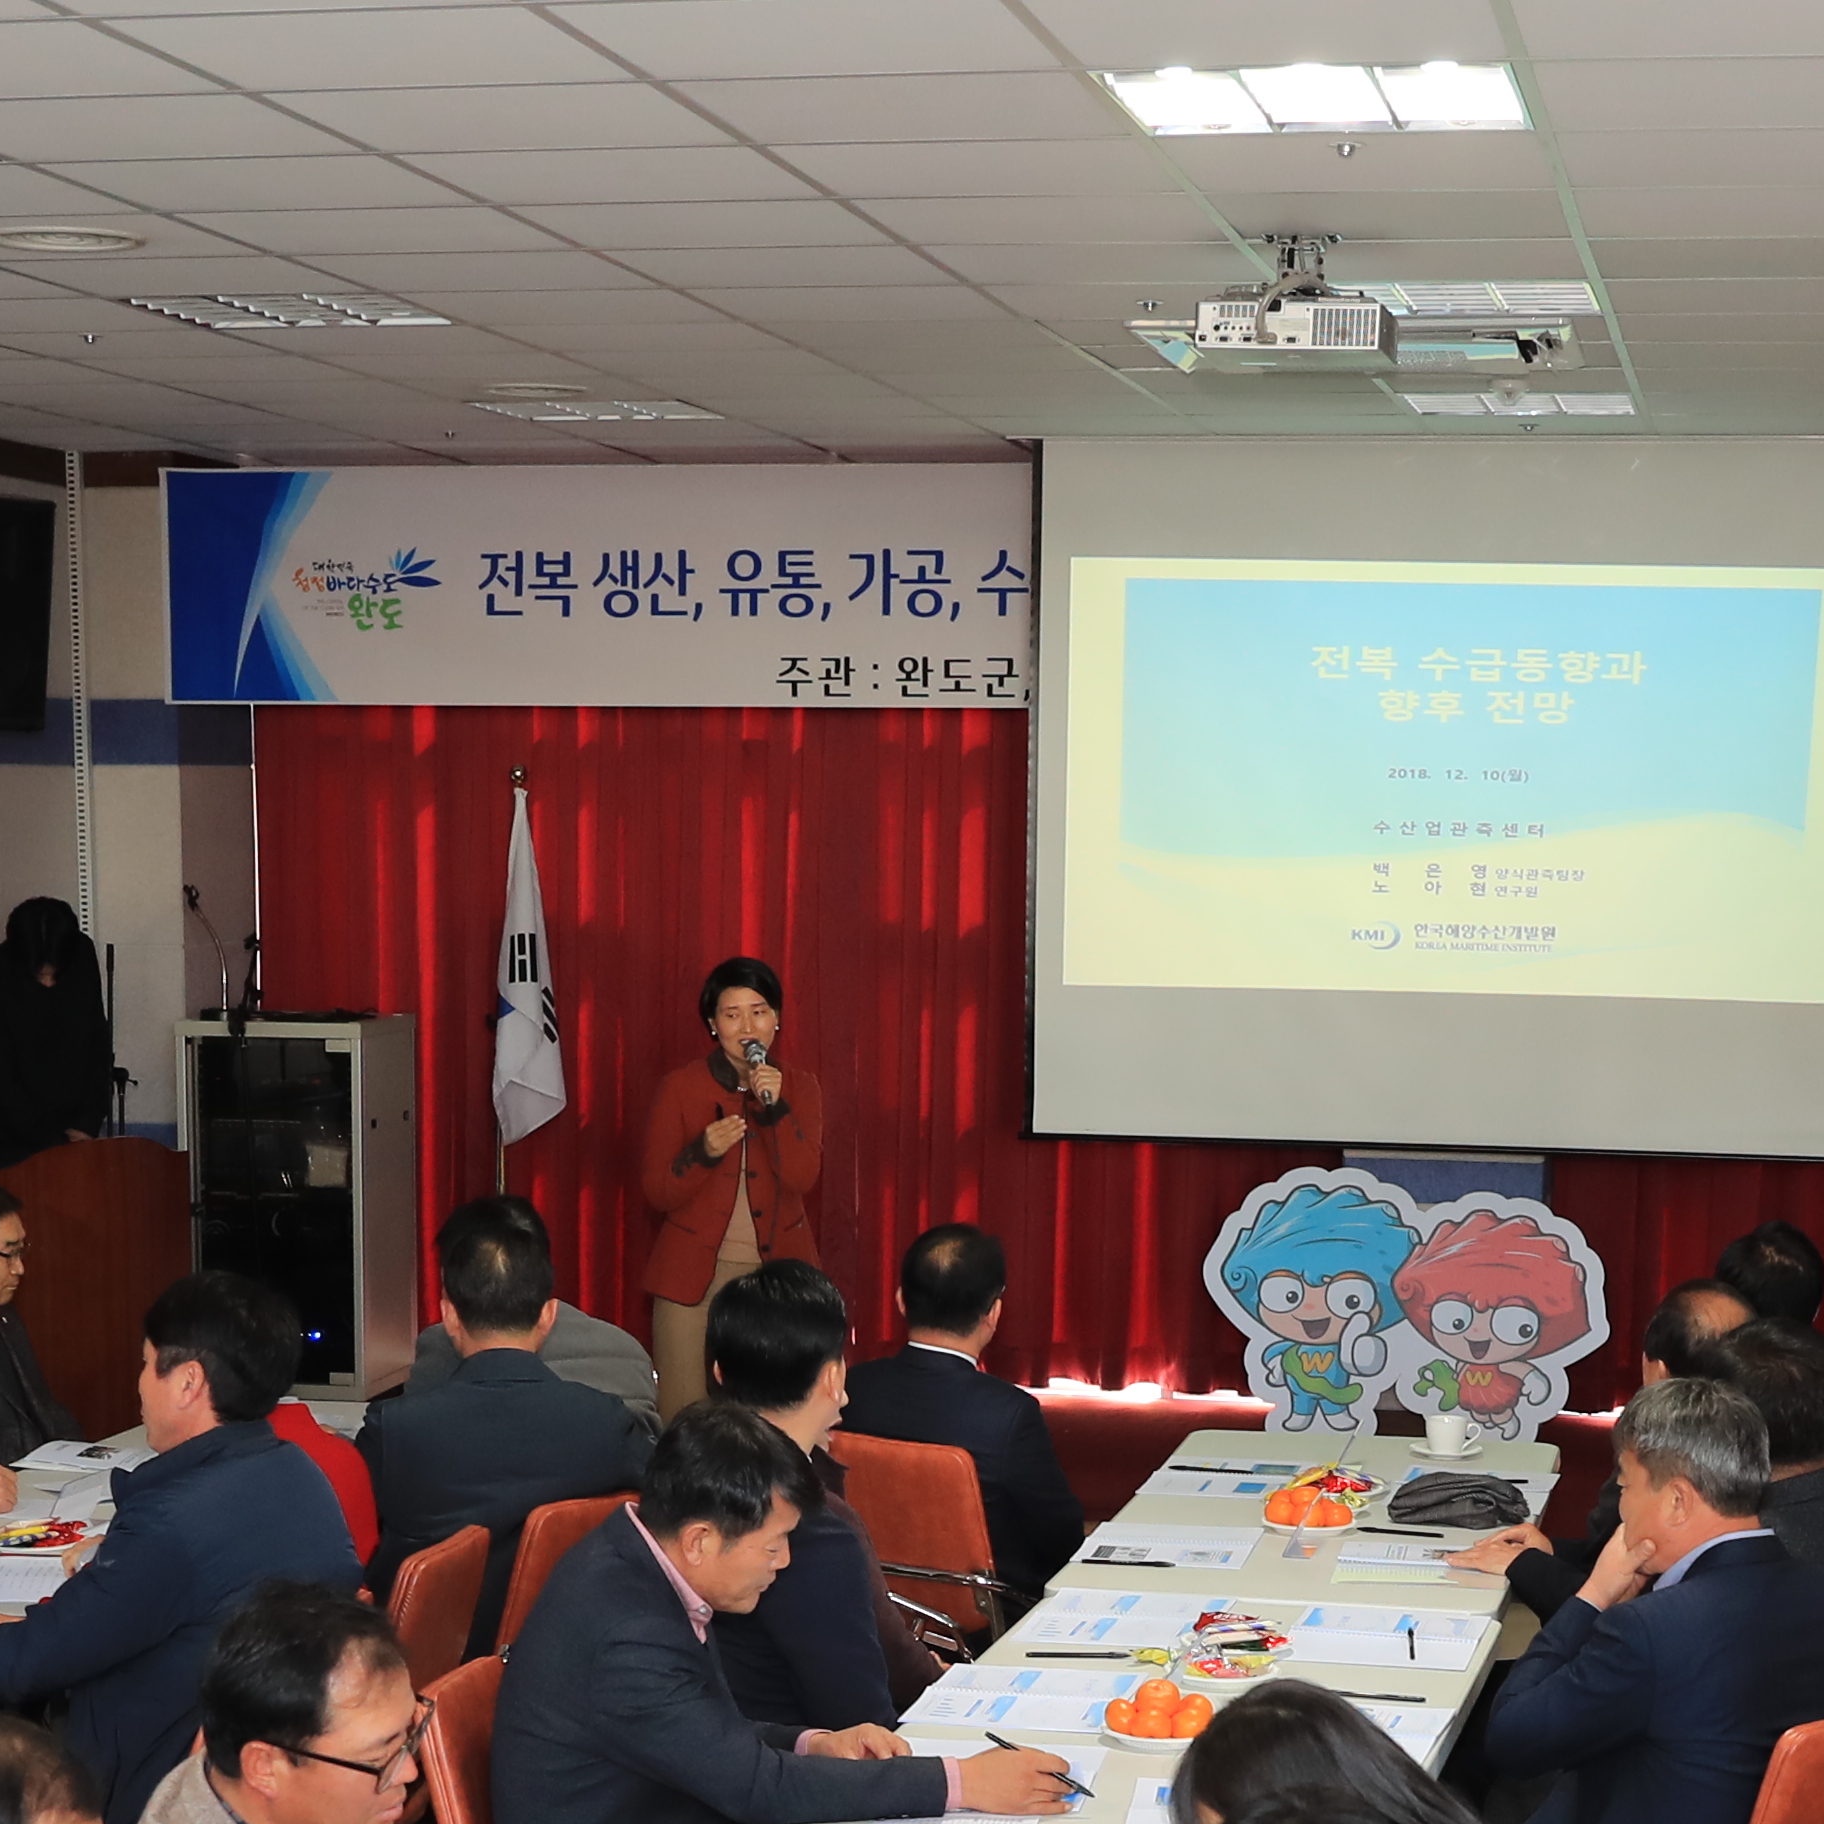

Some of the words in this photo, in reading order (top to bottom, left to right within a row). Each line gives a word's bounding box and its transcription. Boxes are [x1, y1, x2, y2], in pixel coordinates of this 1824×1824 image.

[478, 550, 578, 618] 전복
[592, 549, 703, 622] 생산,
[719, 549, 832, 622] 유통,
[848, 549, 961, 622] 가공,
[347, 593, 404, 631] 완도
[1311, 644, 1397, 682] 전복
[1418, 646, 1647, 685] 수급동향과
[776, 656, 855, 698] 주관
[895, 656, 1031, 702] 완도군,
[1377, 688, 1465, 724] 향후
[1486, 689, 1574, 725] 전망
[1388, 768, 1431, 779] 2018.
[1445, 769, 1468, 780] 12.
[1482, 768, 1529, 783] 10(월)
[1494, 886, 1538, 898] 연구원
[1351, 929, 1385, 941] KMI
[1413, 923, 1556, 941] 한국해양수산개발원
[1414, 941, 1447, 950] KOREA
[1450, 942, 1500, 952] MARITIME
[1302, 1351, 1334, 1372] W
[1466, 1370, 1493, 1387] W
